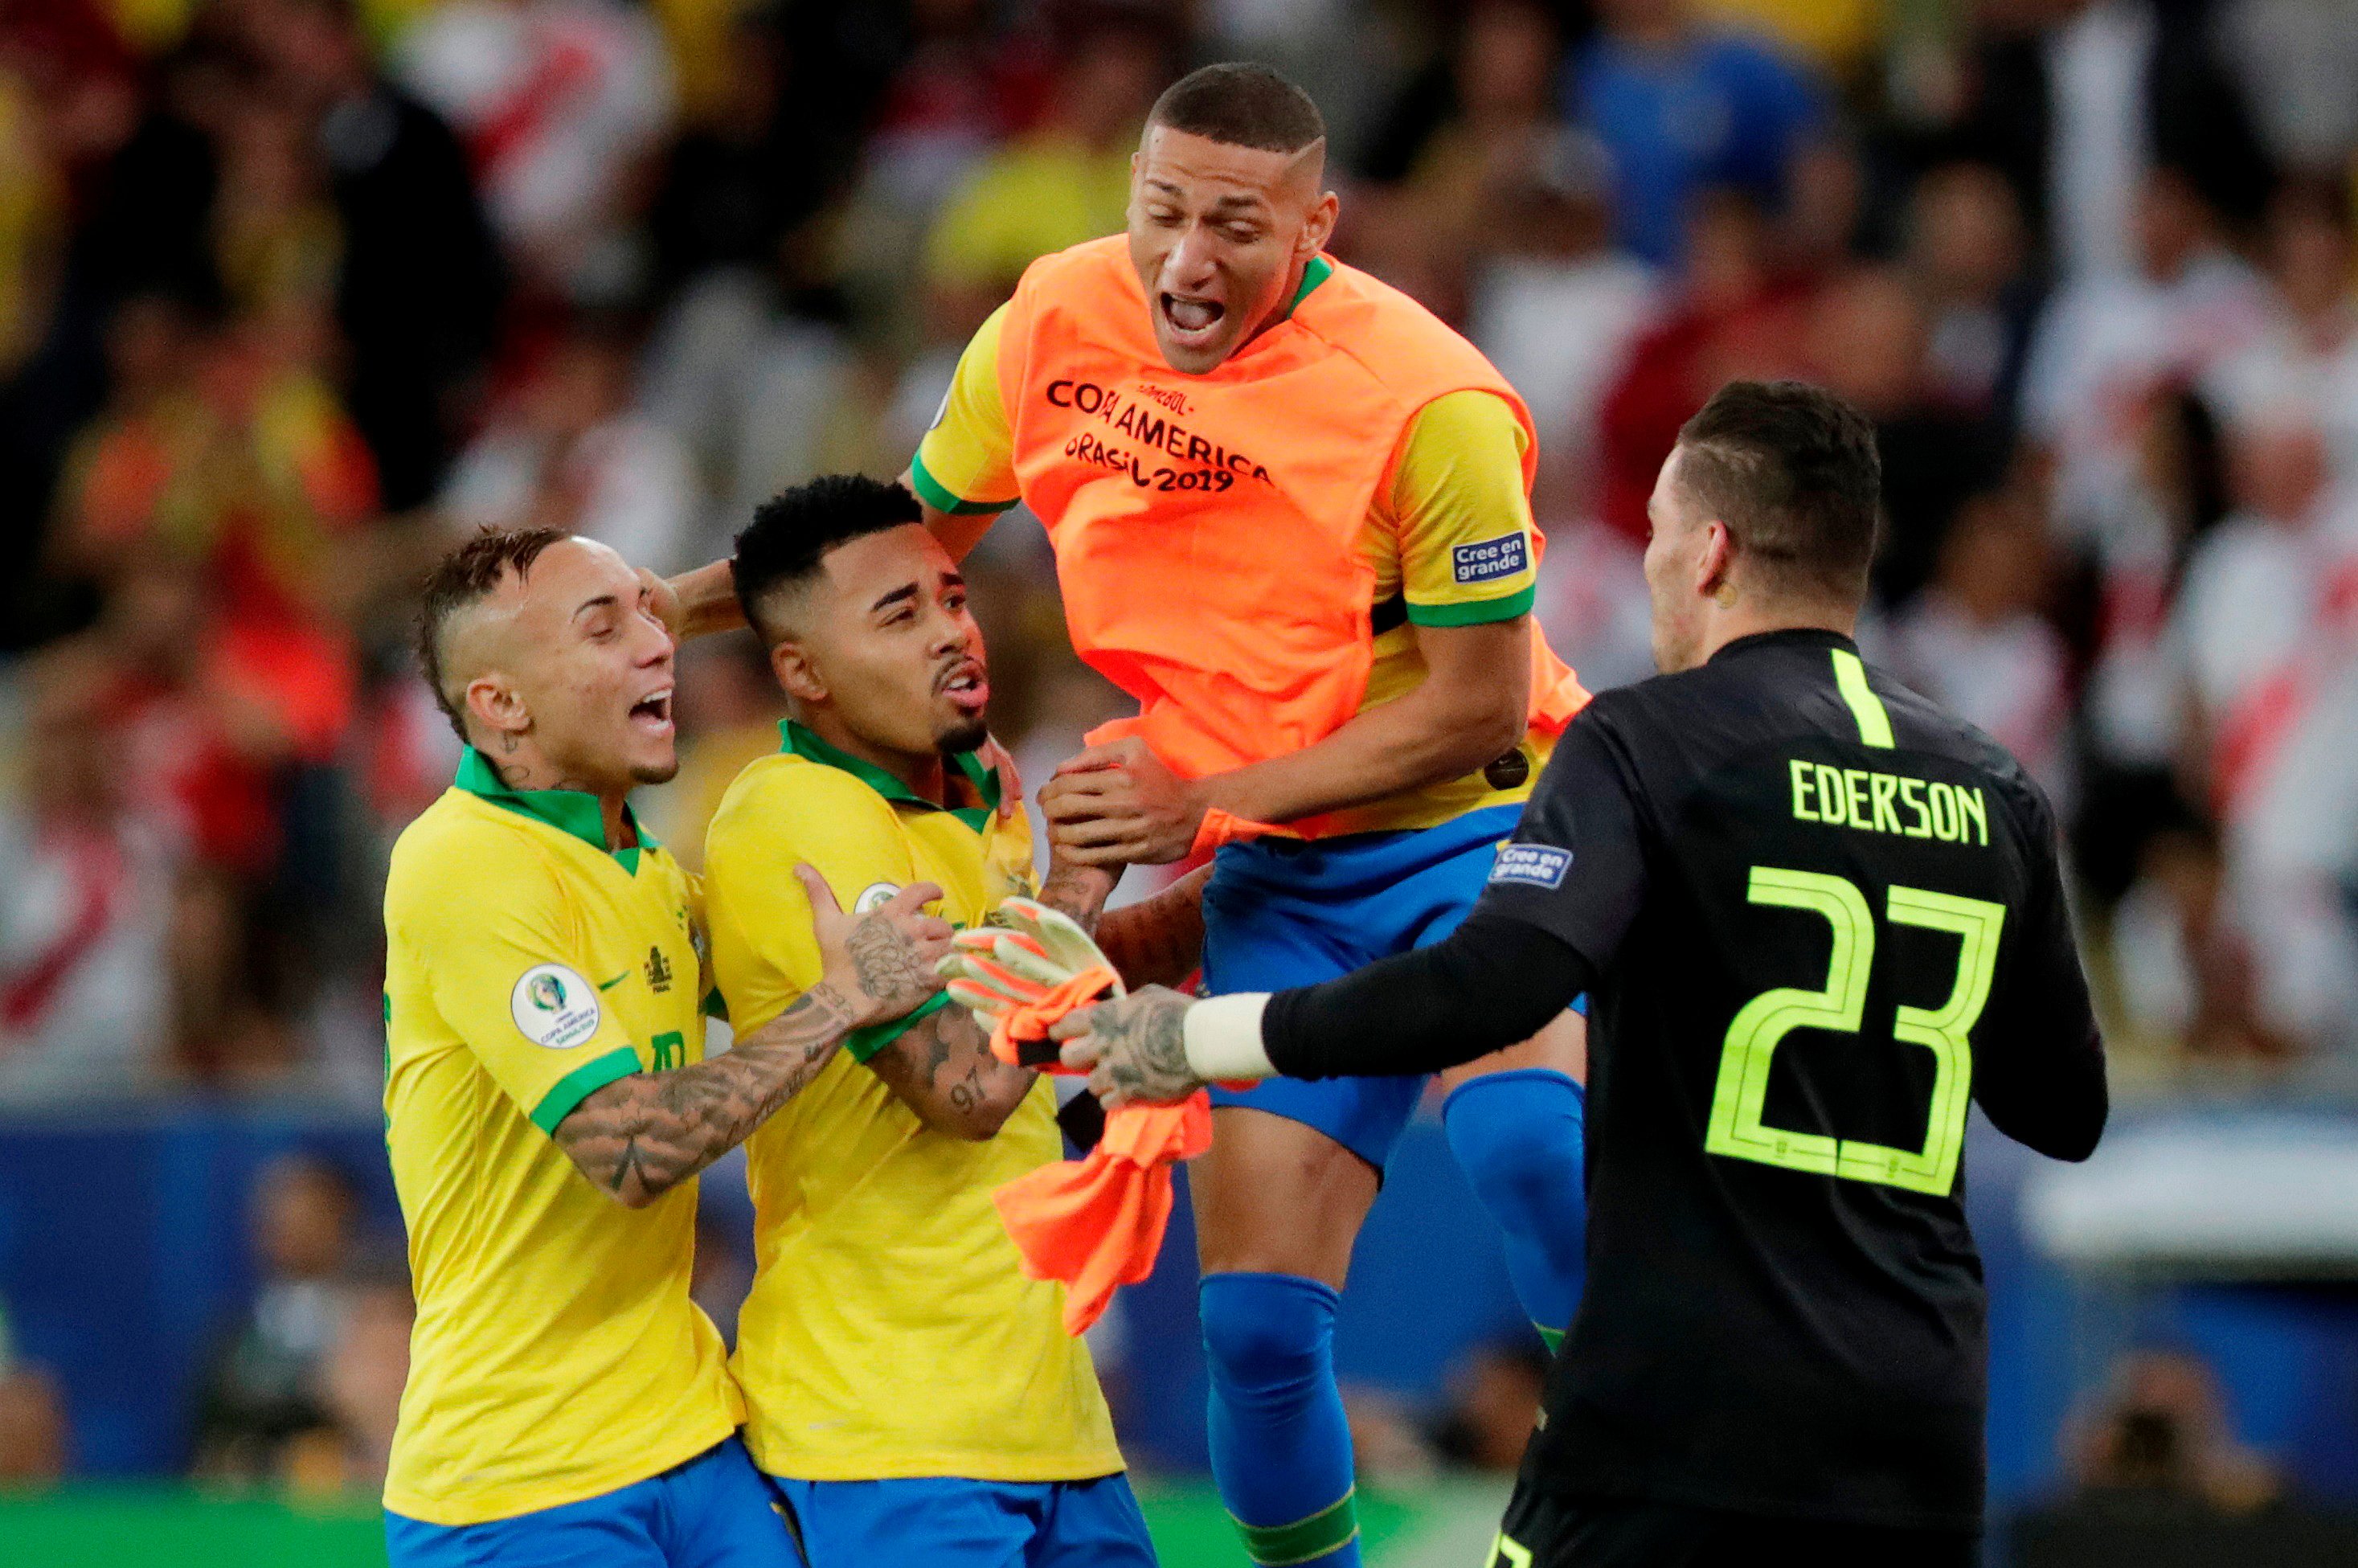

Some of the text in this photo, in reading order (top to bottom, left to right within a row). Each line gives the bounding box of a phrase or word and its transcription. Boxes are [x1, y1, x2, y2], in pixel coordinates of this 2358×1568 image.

[1115, 403, 1275, 488] AMERICA
[1152, 468, 1234, 493] 2019
[1456, 539, 1521, 563] Cree en
[1458, 555, 1520, 580] grande
[1789, 759, 1988, 847] EDERSON
[1493, 863, 1554, 879] grande
[1501, 849, 1563, 868] Cree en
[1705, 866, 2006, 1197] 23
